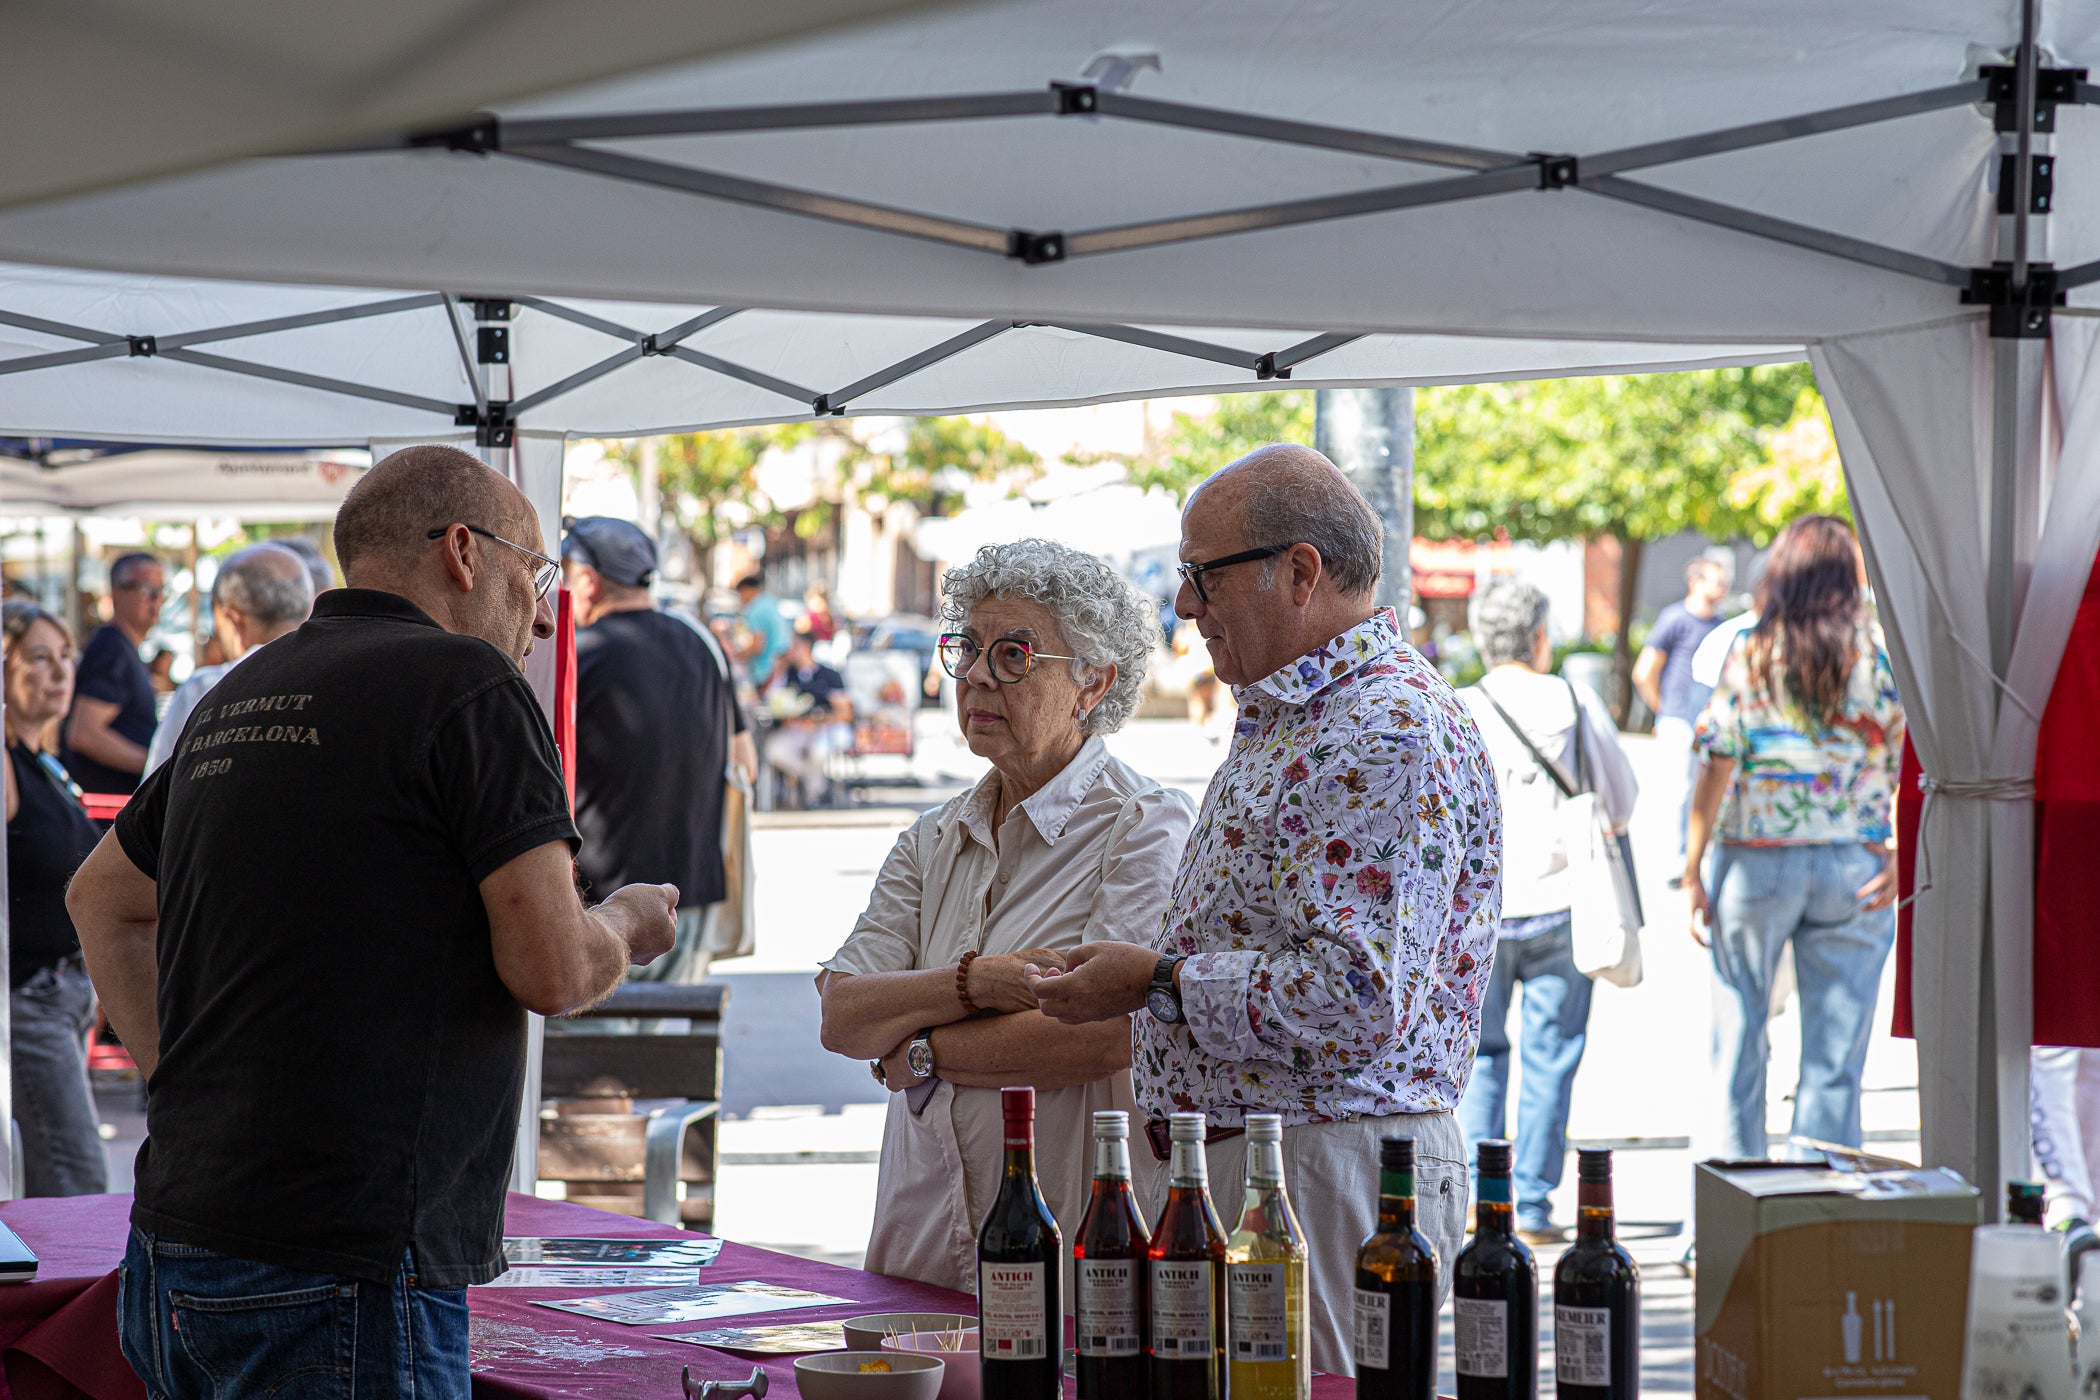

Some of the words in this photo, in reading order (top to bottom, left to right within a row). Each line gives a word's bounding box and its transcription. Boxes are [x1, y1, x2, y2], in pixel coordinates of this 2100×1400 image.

[219, 694, 313, 719] VERMUT
[190, 725, 321, 753] BARCELONA
[190, 757, 233, 780] 1850
[991, 1271, 1033, 1281] ANTICH
[1085, 1268, 1127, 1278] ANTICH
[1158, 1270, 1199, 1280] ANTICH
[1232, 1273, 1272, 1283] ANTICH
